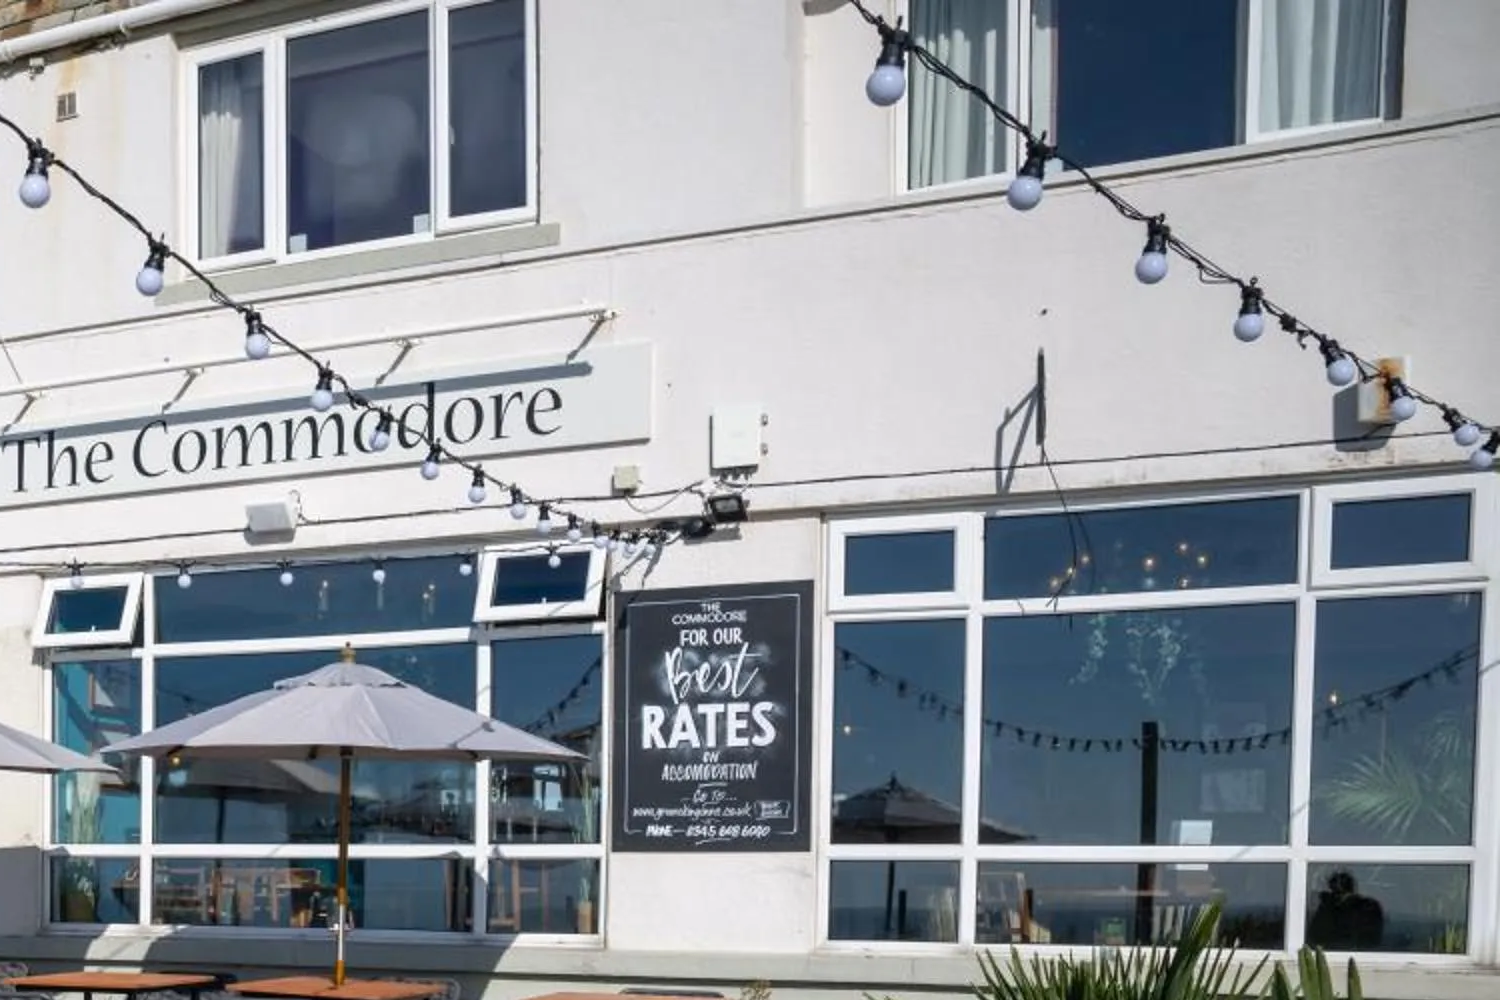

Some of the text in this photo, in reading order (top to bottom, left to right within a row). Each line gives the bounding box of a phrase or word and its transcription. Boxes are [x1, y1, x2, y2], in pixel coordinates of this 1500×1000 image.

[2, 382, 563, 494] The Commodore
[700, 602, 720, 612] THE
[671, 610, 747, 625] COMMODORE
[680, 627, 743, 646] FOR OUR
[665, 642, 763, 704] Best
[642, 701, 777, 749] RATES
[702, 751, 720, 763] ON
